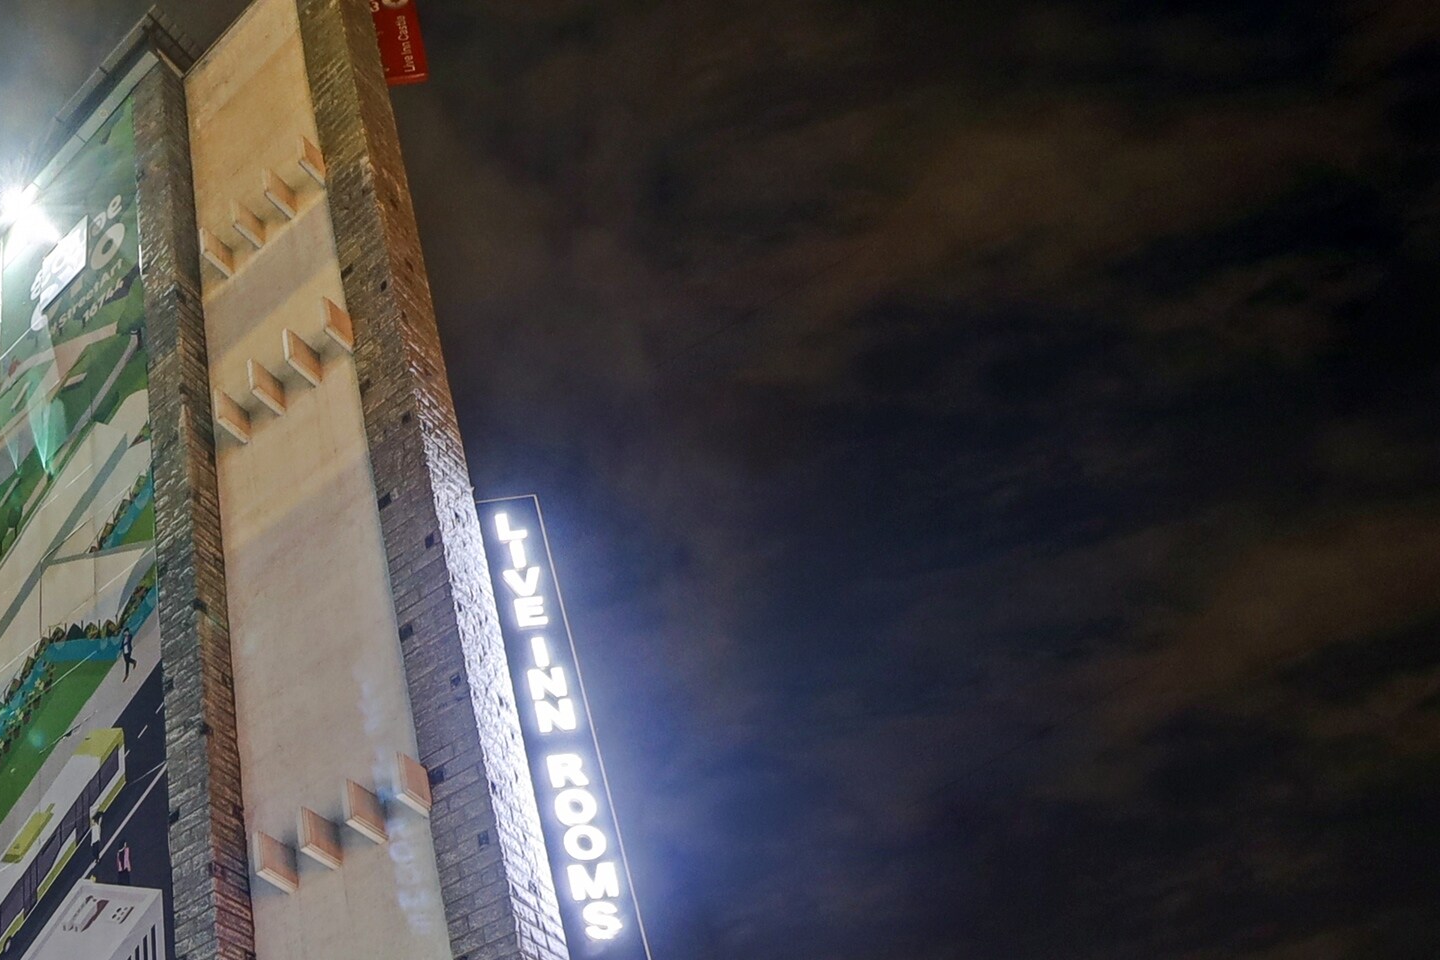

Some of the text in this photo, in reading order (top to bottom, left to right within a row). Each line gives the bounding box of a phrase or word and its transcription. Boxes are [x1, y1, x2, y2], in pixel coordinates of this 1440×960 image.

[494, 513, 623, 940] LIVE INN ROOMS
